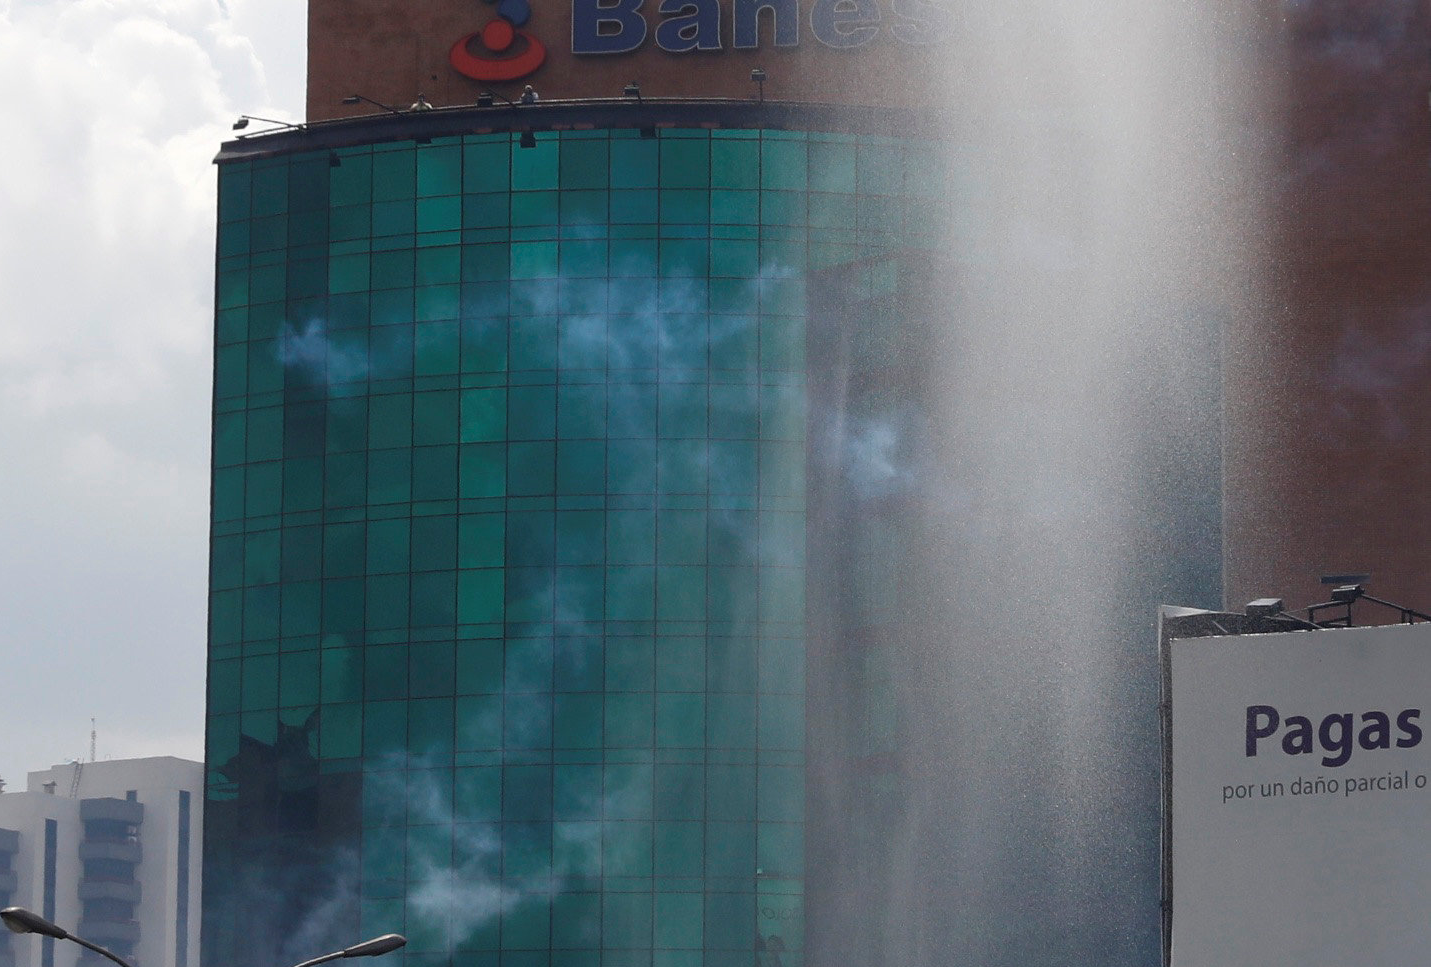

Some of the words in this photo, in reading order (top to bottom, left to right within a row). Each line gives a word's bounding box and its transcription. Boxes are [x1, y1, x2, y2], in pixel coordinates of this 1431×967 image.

[1245, 704, 1423, 768] Pagas
[1222, 783, 1254, 804] por
[1260, 781, 1284, 797] un
[1290, 776, 1339, 796] daño
[1345, 770, 1409, 797] parcial
[1414, 774, 1427, 788] o
